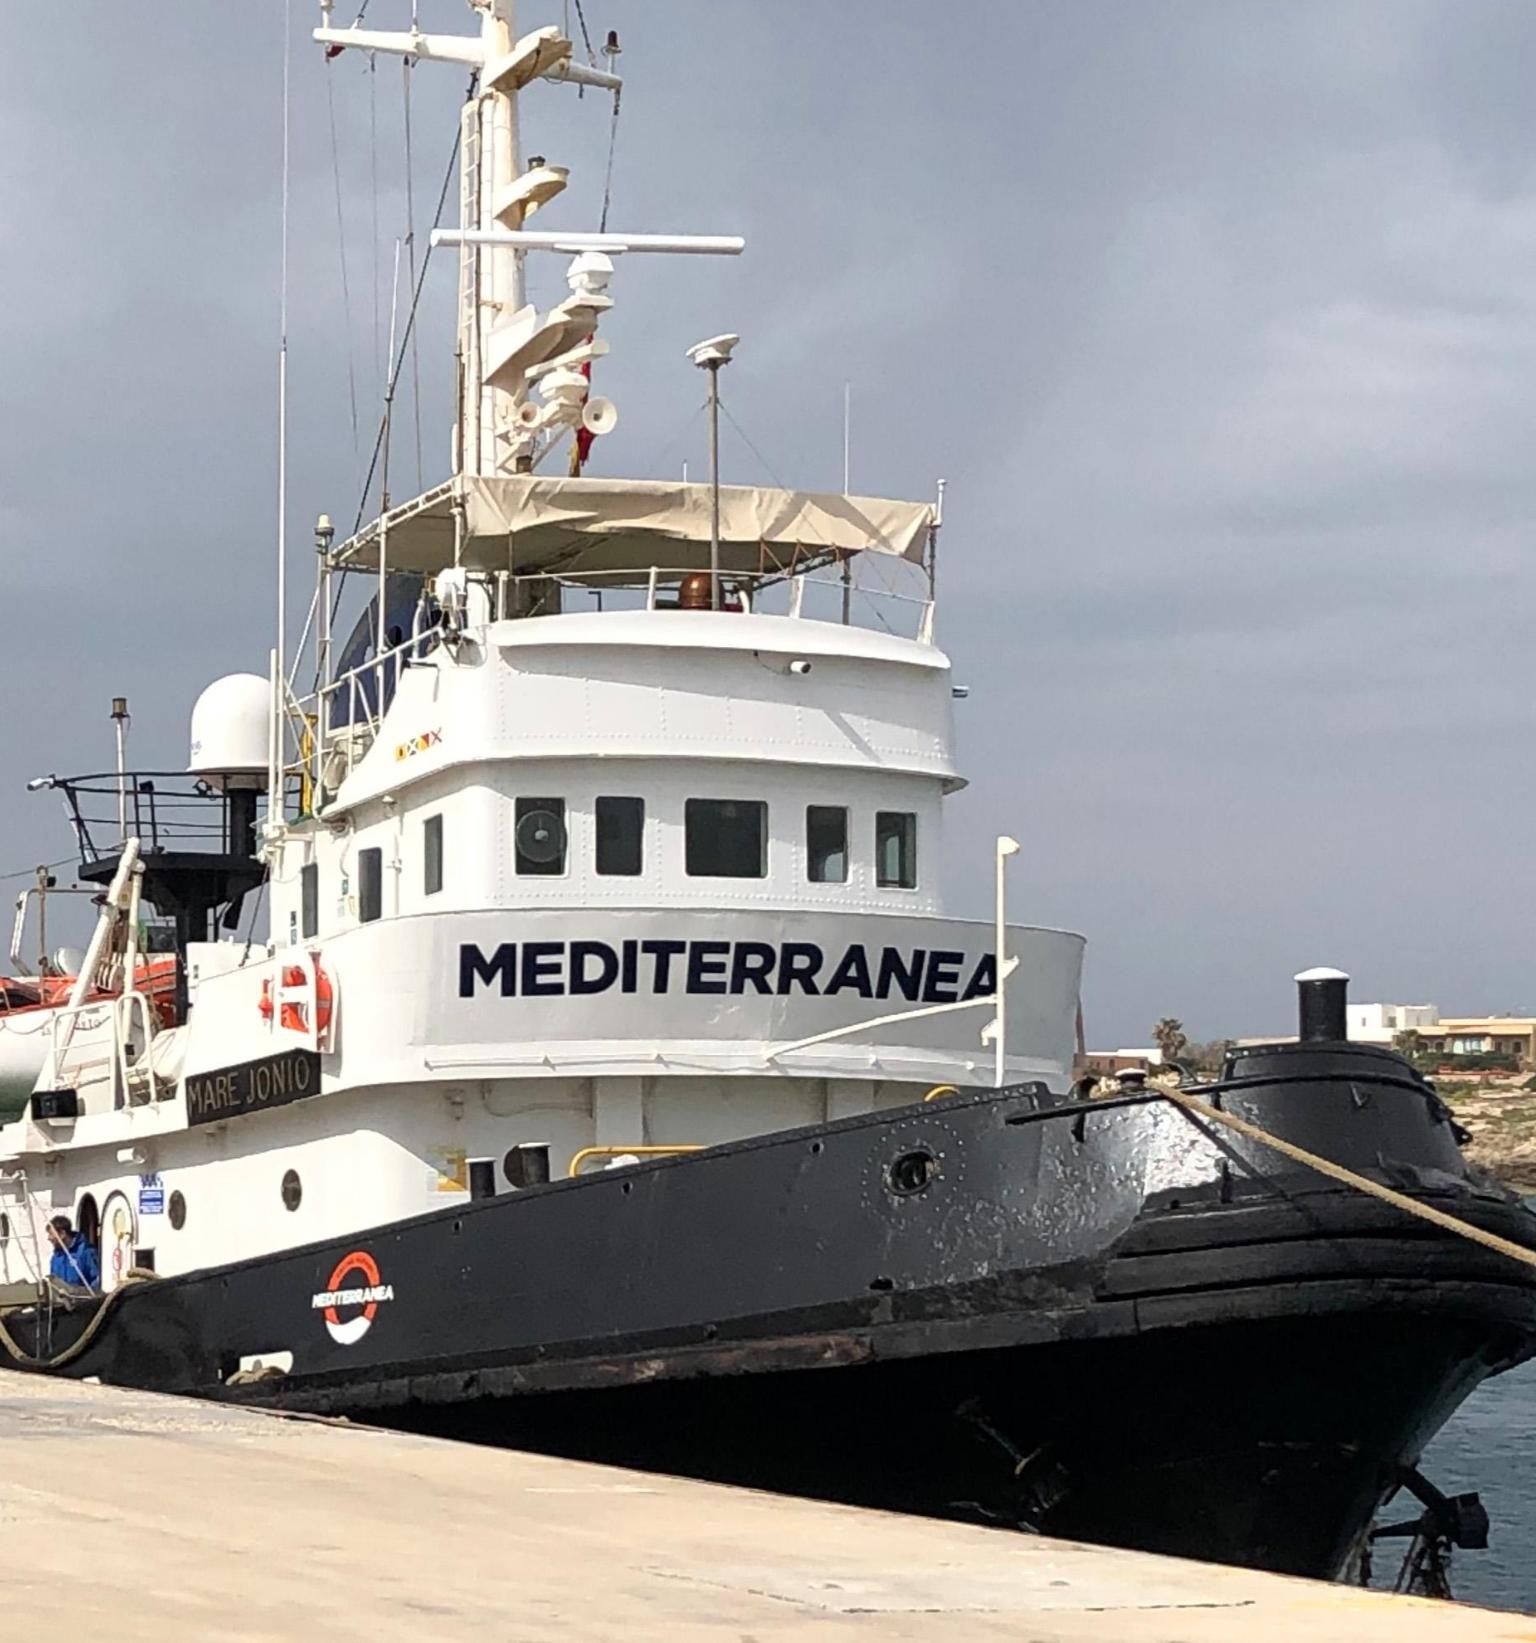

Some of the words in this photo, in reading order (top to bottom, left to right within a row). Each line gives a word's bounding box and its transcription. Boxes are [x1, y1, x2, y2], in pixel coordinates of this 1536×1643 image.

[459, 939, 997, 1002] MEDITERRANEA
[188, 1072, 241, 1118] MARE
[245, 1055, 310, 1105] JONIO
[311, 1284, 394, 1309] MEDITERRANEA
